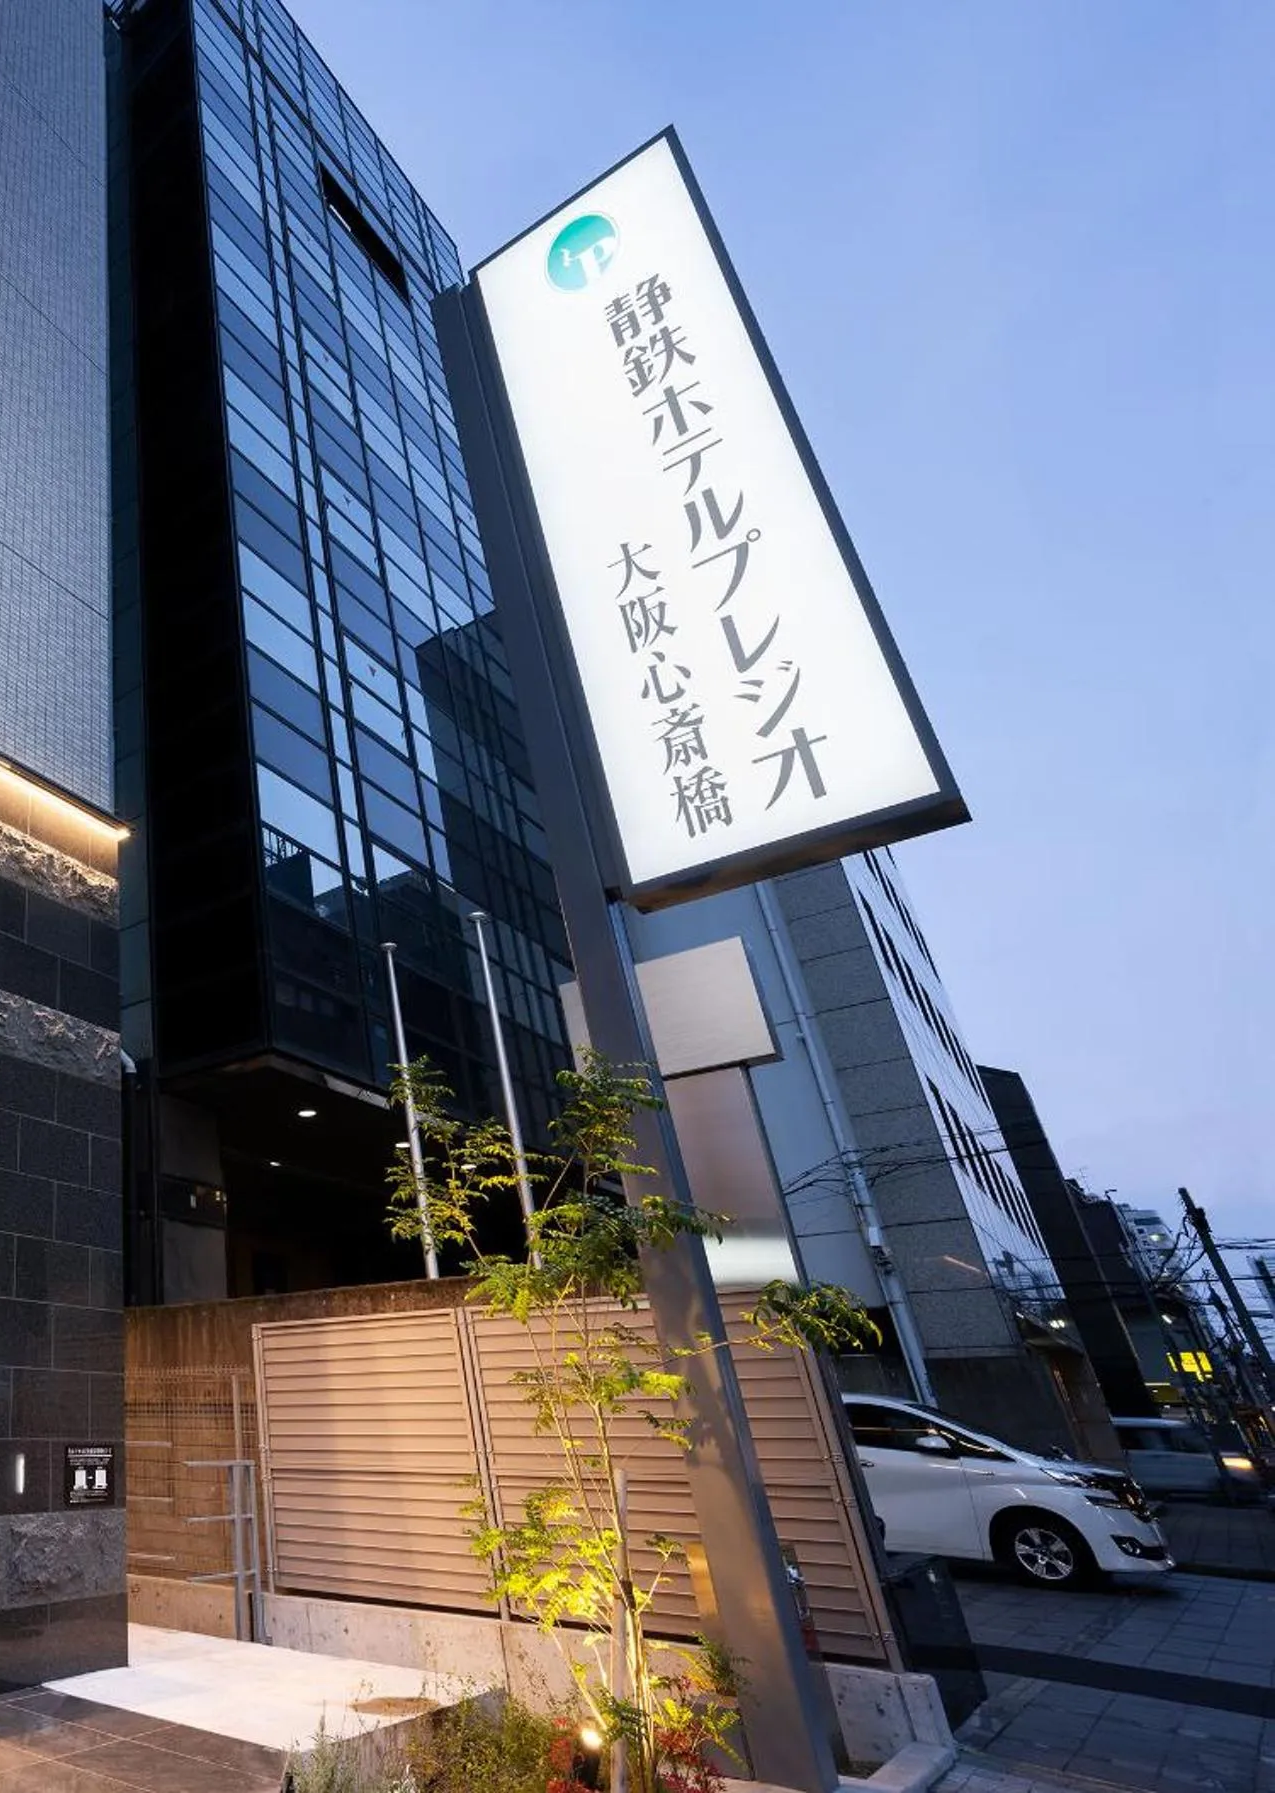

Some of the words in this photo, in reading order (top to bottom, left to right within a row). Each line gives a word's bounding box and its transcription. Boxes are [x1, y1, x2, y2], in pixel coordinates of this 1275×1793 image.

[604, 273, 828, 811] 静鉄ホテルプレジオ
[607, 541, 734, 839] 大阪心斎橋
